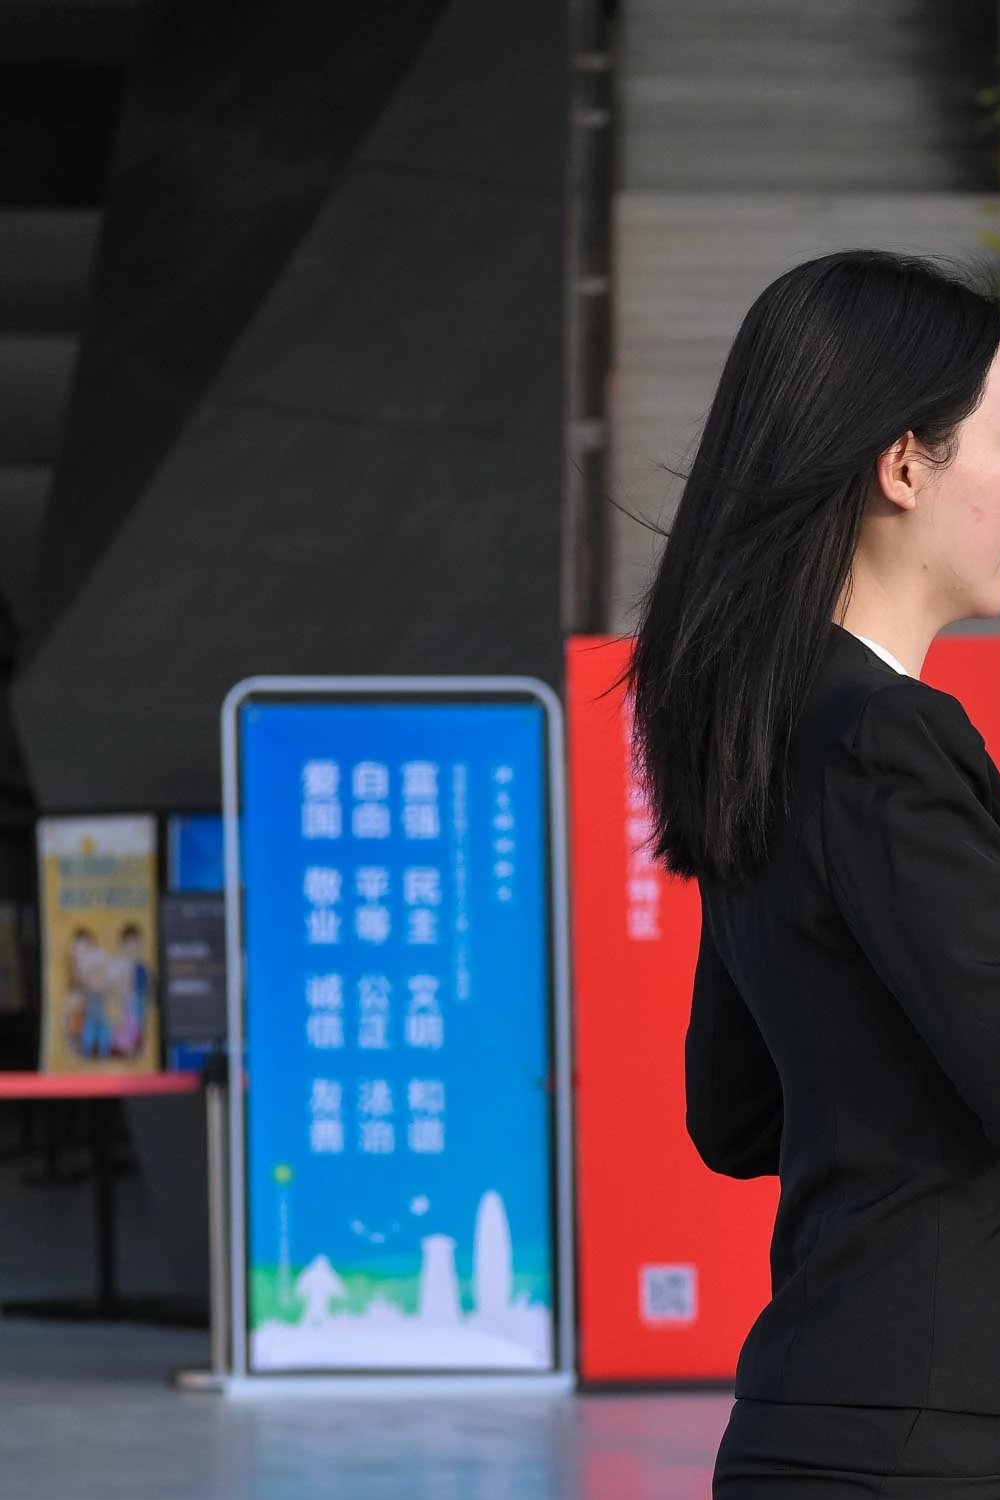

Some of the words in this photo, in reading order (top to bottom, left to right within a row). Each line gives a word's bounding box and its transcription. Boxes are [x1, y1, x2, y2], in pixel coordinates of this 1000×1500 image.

[303, 760, 341, 838] 爱国
[353, 762, 390, 838] 自由
[305, 867, 341, 943] 敬业
[357, 867, 390, 943] 平等
[405, 868, 439, 943] 民主
[306, 974, 342, 1048] 诚信
[358, 975, 390, 1048] 公正
[406, 975, 443, 1047] 文明
[310, 1079, 343, 1153] 友善
[358, 1080, 394, 1153] 法治
